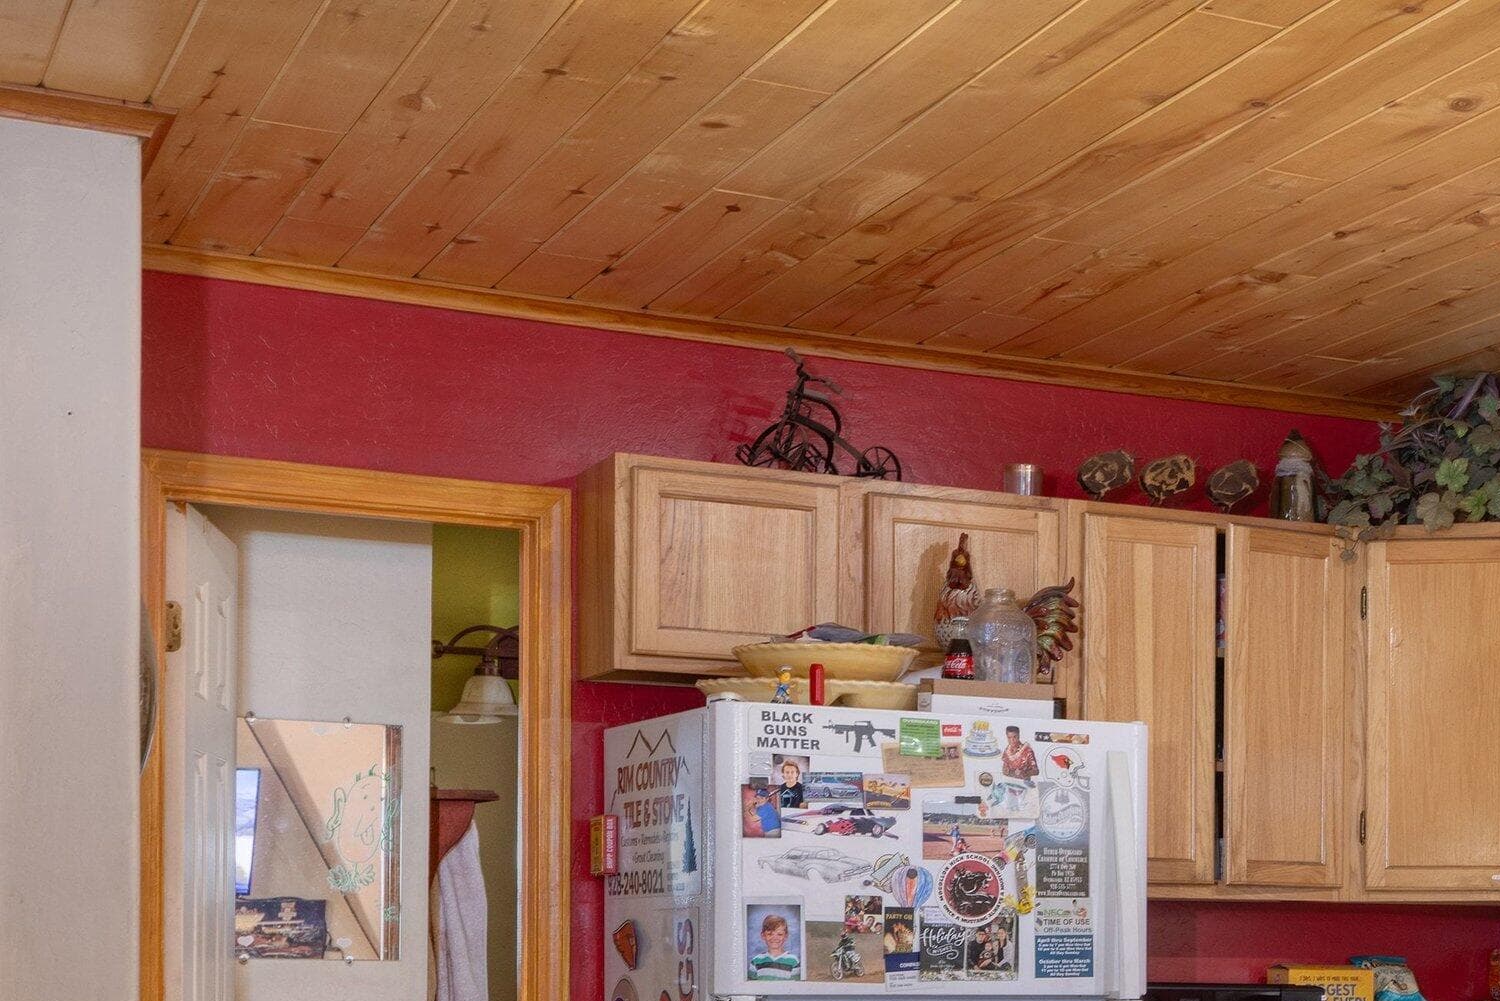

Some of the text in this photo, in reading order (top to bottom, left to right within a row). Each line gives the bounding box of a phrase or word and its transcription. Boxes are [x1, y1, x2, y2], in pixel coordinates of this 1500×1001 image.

[761, 710, 814, 724] BLACK
[763, 724, 808, 736] GUNS
[756, 736, 821, 751] MATTER
[617, 756, 682, 795] RIM COUNTRY
[624, 794, 685, 829] TILE & STONE
[1043, 918, 1090, 926] TIME OF USE
[920, 926, 968, 948] Holiday
